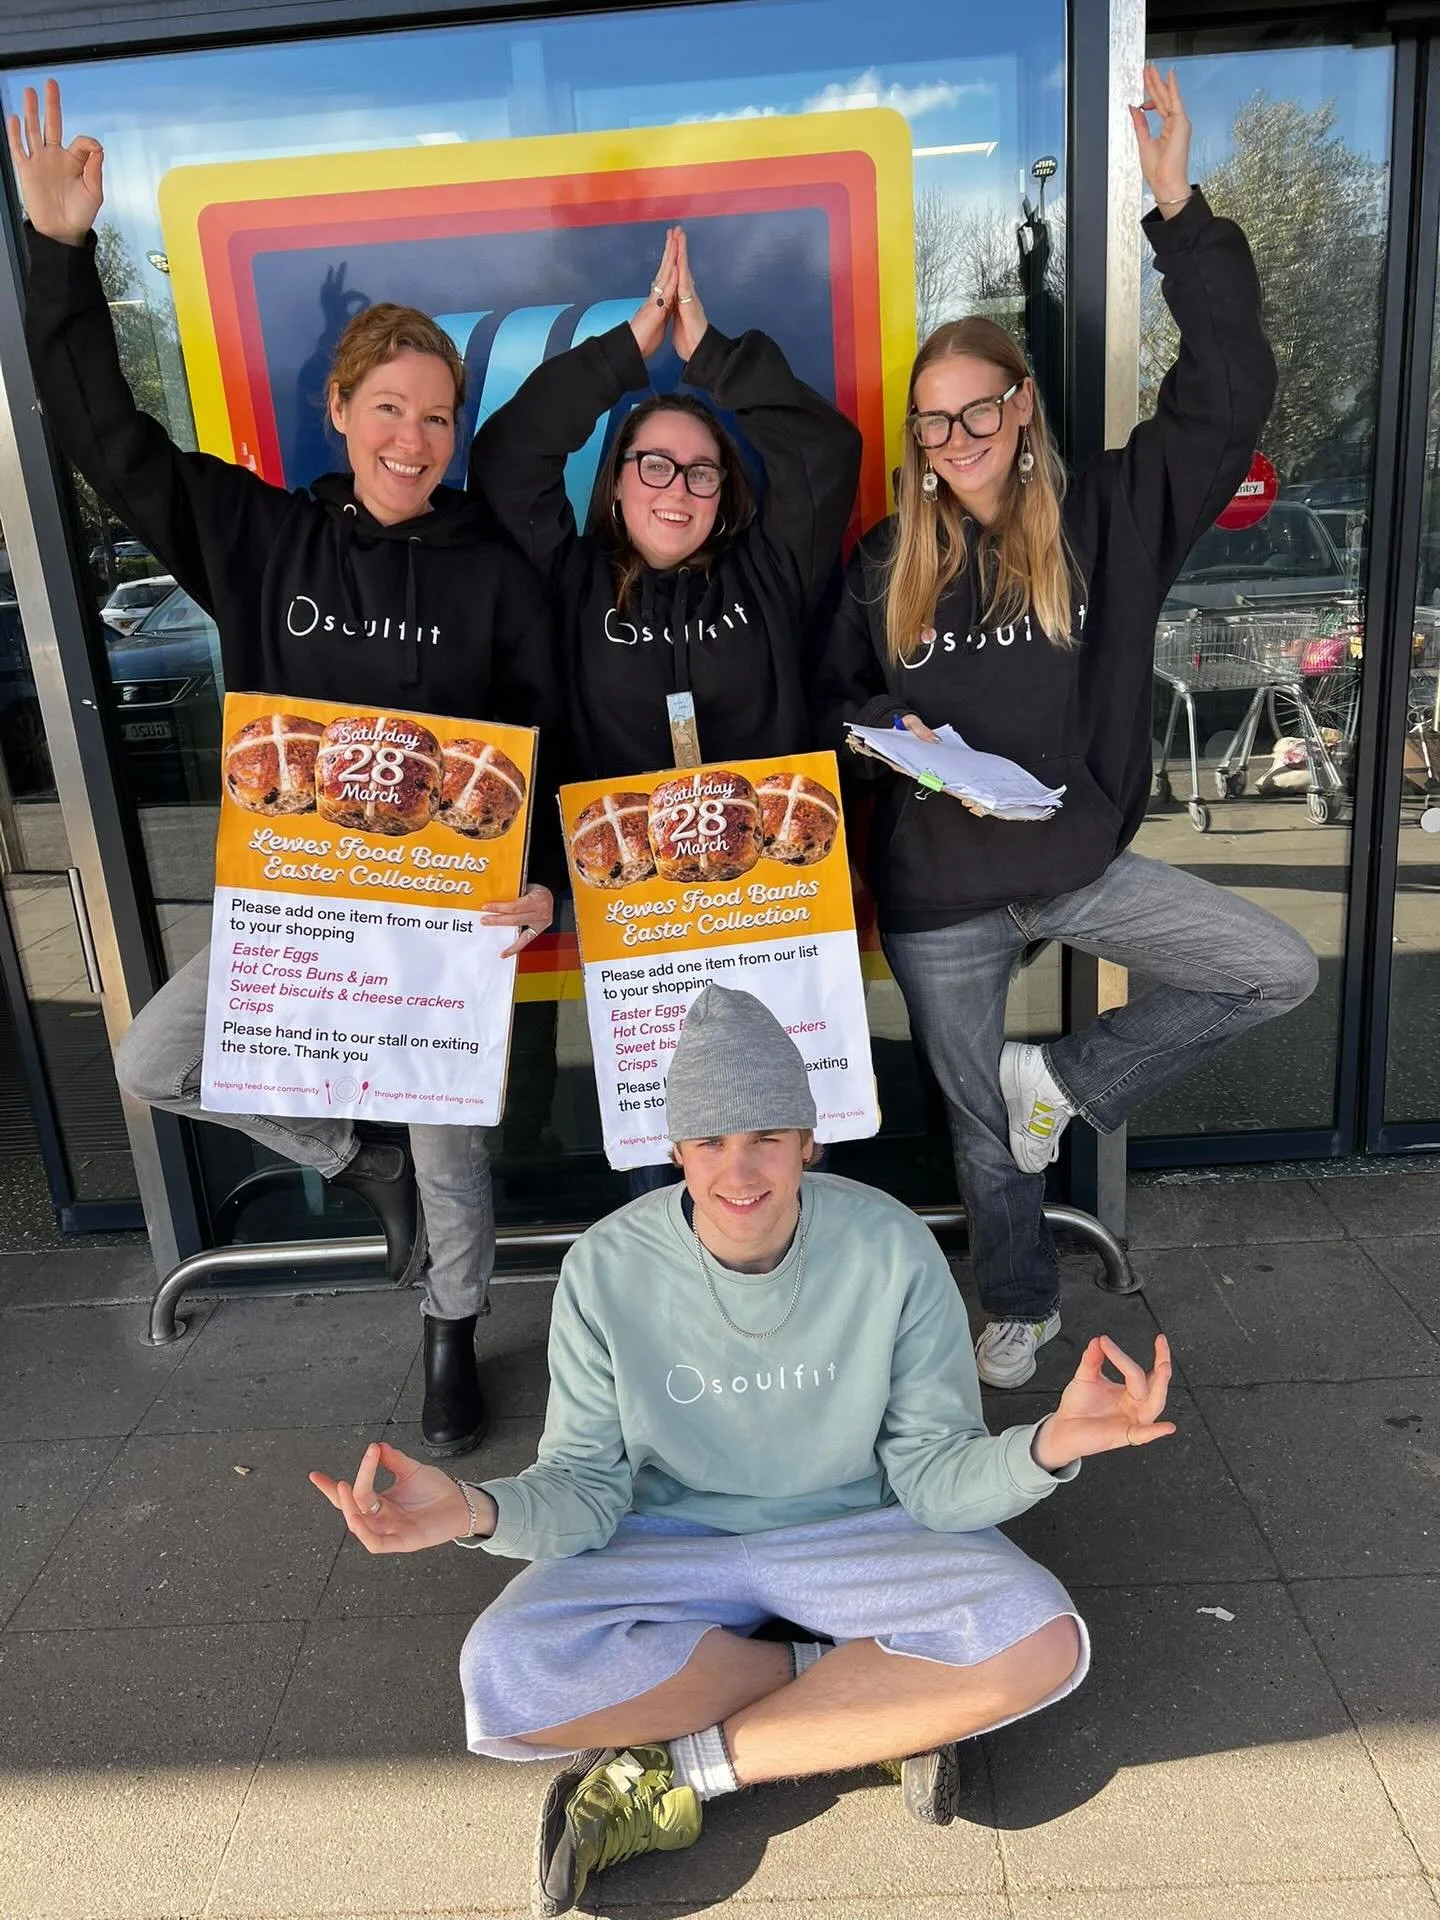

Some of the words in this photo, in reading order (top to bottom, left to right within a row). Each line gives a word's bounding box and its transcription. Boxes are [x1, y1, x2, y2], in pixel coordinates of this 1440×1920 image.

[1238, 484, 1259, 494] ntry
[943, 604, 1086, 652] soult
[338, 726, 421, 750] Saturday
[337, 743, 405, 786] 28
[336, 783, 402, 805] March
[662, 780, 735, 806] Saturday
[670, 799, 727, 841] 28
[248, 827, 332, 856] Lewes
[335, 836, 405, 863] Food
[410, 846, 489, 872] Banks
[673, 839, 730, 860] March
[263, 855, 345, 882] Easter
[348, 864, 474, 894] Collection
[231, 898, 282, 916] Please
[284, 904, 314, 919] add
[317, 910, 346, 922] one
[349, 908, 383, 925] item
[386, 912, 421, 929] from
[424, 919, 450, 931] our
[452, 918, 474, 934] list
[605, 898, 677, 925] Lewes
[681, 887, 744, 913] Food
[747, 879, 820, 904] Banks
[229, 916, 246, 931] to
[249, 921, 283, 935] your
[285, 921, 355, 944] shopping
[622, 921, 693, 946] Easter
[697, 904, 811, 934] Collection
[231, 942, 281, 958] Easter
[282, 946, 320, 964] Eggs
[600, 969, 646, 983] Please
[648, 962, 674, 978] add
[676, 962, 703, 974] one
[704, 957, 736, 971] item
[737, 953, 771, 967] from
[773, 949, 797, 962] our
[798, 944, 819, 959] list
[231, 960, 259, 975] Hot
[261, 962, 303, 979] Cross
[305, 967, 344, 983] Buns
[346, 970, 358, 984] &
[358, 971, 389, 988] jam
[228, 997, 274, 1015] Crisps
[229, 978, 277, 995] Sweet
[278, 983, 335, 1001] biscuits
[337, 988, 349, 1001] &
[352, 989, 404, 1006] cheese
[406, 995, 465, 1010] crackers
[602, 987, 618, 1000] to
[619, 985, 649, 1001] your
[610, 1007, 652, 1022] Easter
[654, 1004, 687, 1019] Eggs
[222, 1020, 273, 1038] Please
[275, 1024, 313, 1041] hand
[315, 1027, 329, 1042] in
[331, 1029, 348, 1043] to
[350, 1033, 376, 1045] our
[377, 1033, 408, 1047] stall
[410, 1037, 429, 1048] on
[431, 1036, 479, 1055] exiting
[613, 1024, 637, 1039] Hot
[639, 1022, 676, 1035] Cross
[615, 1039, 656, 1056] Sweet
[784, 1020, 827, 1034] ackers
[220, 1039, 247, 1054] the
[249, 1041, 291, 1057] store.
[294, 1043, 340, 1061] Thank
[342, 1050, 369, 1064] you
[617, 1058, 658, 1072] Crisps
[616, 1081, 661, 1096] Please
[805, 1057, 849, 1070] exiting
[617, 1098, 641, 1113] the
